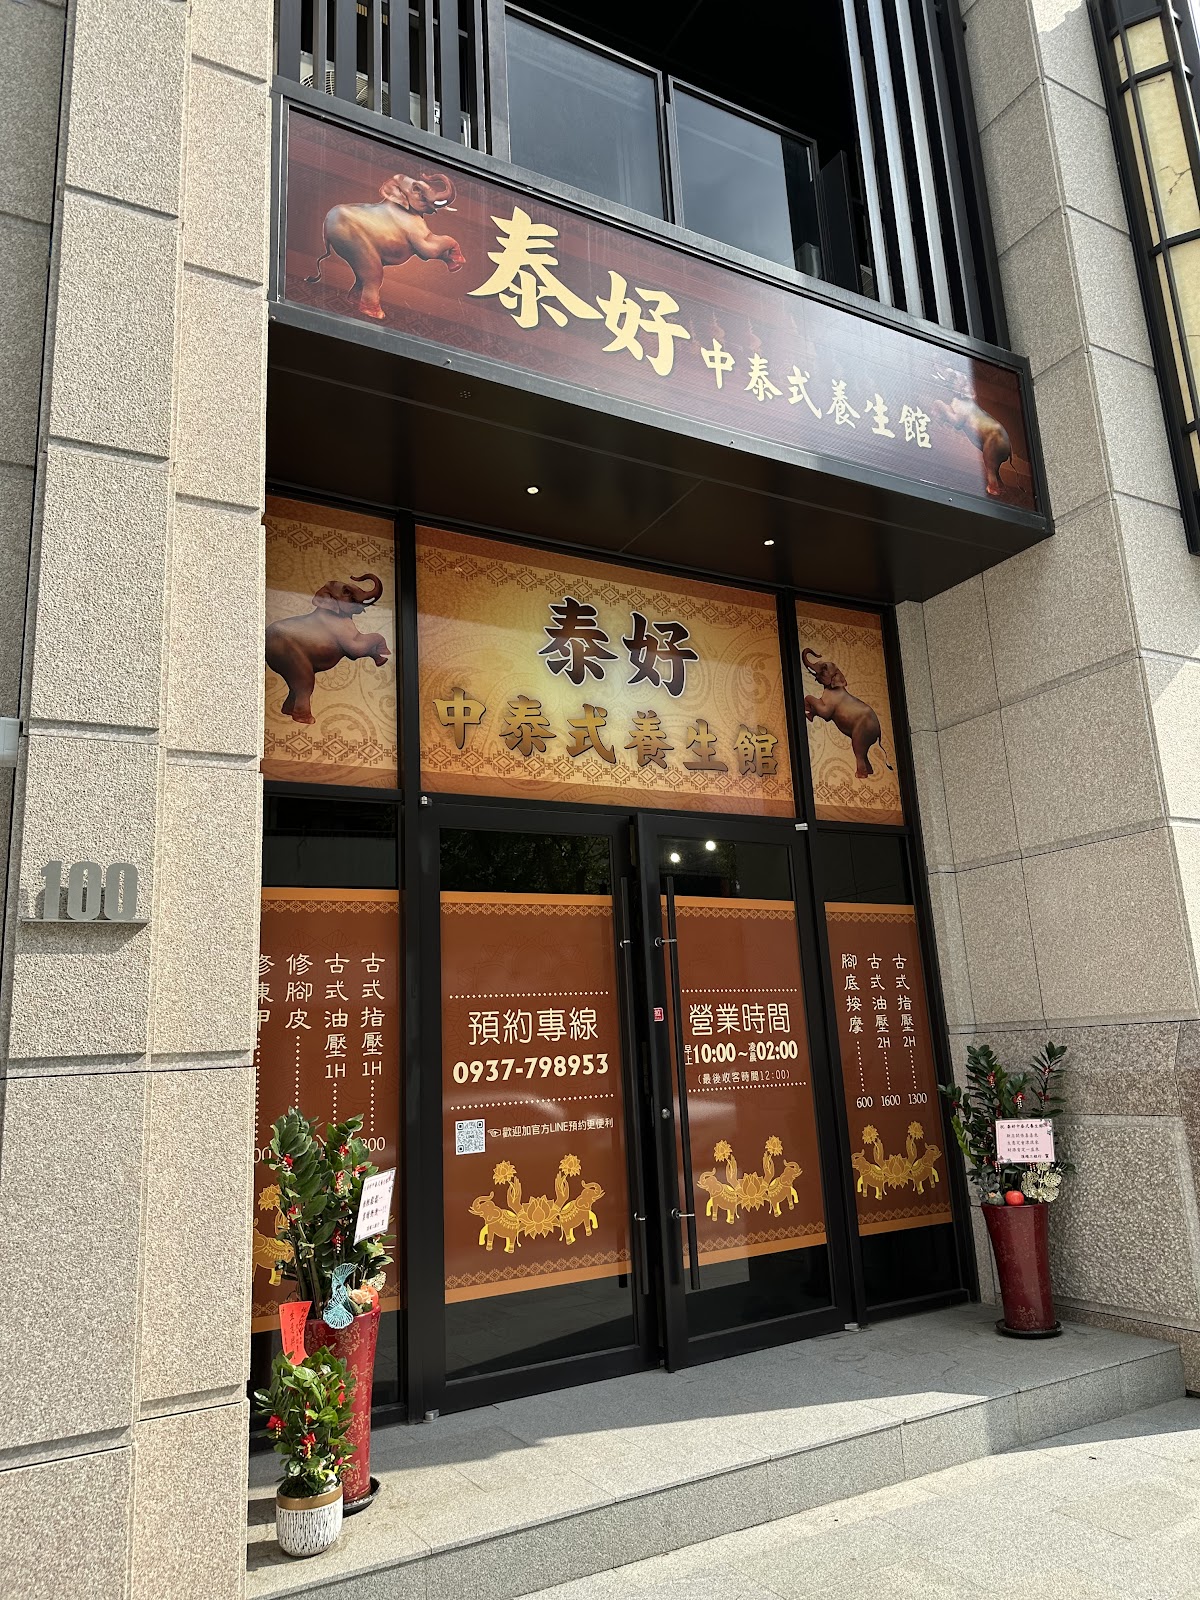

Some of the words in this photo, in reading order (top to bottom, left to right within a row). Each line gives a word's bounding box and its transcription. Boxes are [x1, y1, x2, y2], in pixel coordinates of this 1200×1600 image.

[468, 206, 692, 378] 泰好
[700, 339, 933, 451] 中泰式養生館
[536, 595, 700, 699] 泰好
[432, 687, 780, 779] 中泰式養生館
[40, 861, 139, 921] 100
[284, 952, 314, 1030] 修腳皮
[689, 1002, 791, 1036] 營業時間
[467, 1006, 600, 1046] 預約專線
[841, 952, 865, 1035] 腳底按摩
[856, 1095, 874, 1109] 600
[452, 1053, 609, 1084] 0937-798953
[908, 1092, 928, 1105] 1300
[880, 1094, 901, 1107] 1600
